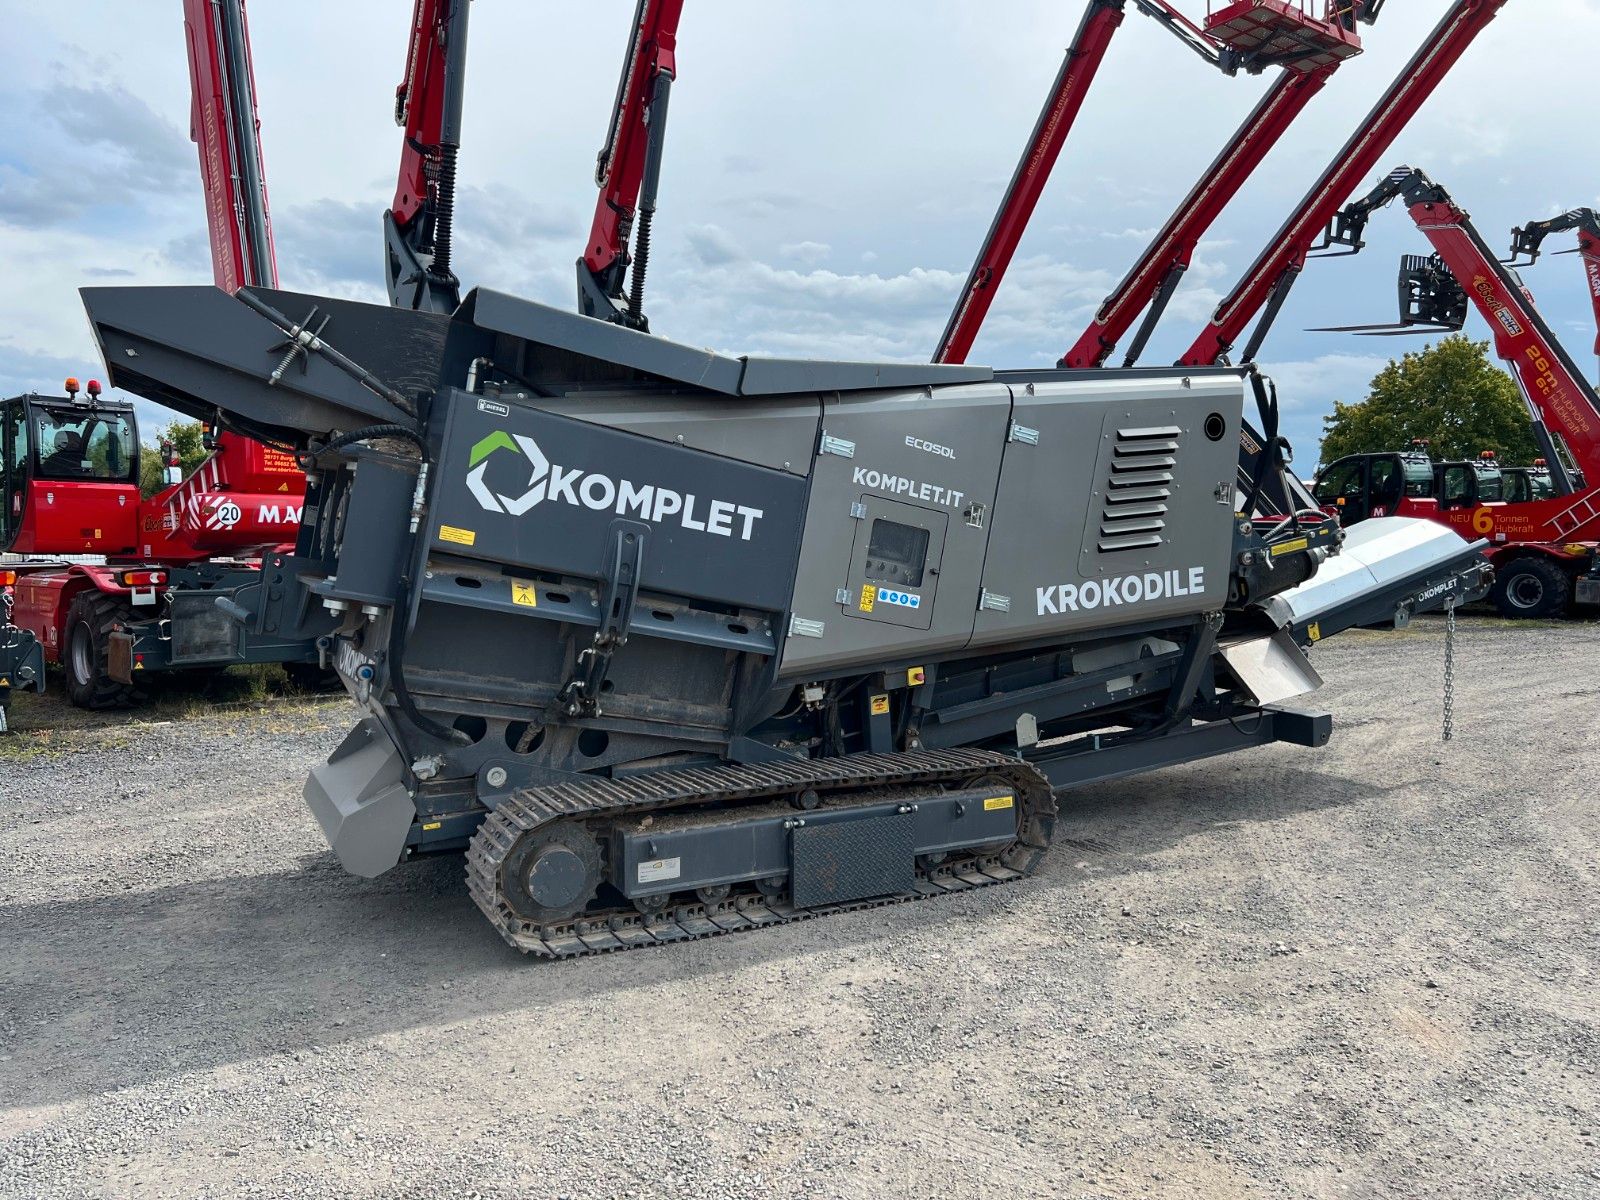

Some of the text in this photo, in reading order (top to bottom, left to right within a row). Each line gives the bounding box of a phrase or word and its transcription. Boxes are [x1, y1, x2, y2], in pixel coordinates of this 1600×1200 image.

[205, 102, 216, 146] mich
[1038, 132, 1050, 152] kann
[1047, 110, 1059, 129] man
[211, 148, 222, 194] kann
[216, 198, 226, 238] man
[1525, 345, 1558, 388] 26m
[1536, 377, 1580, 436] 6t Hubkraft
[547, 464, 763, 541] KOMPLET
[853, 466, 964, 508] KOMPLET.IT
[221, 506, 239, 521] 20
[1449, 507, 1528, 534] NEU 6 Tonnen
[1494, 525, 1534, 533] Hubkraft
[1036, 566, 1205, 616] KROKODILE
[1424, 578, 1458, 600] KOMPLET
